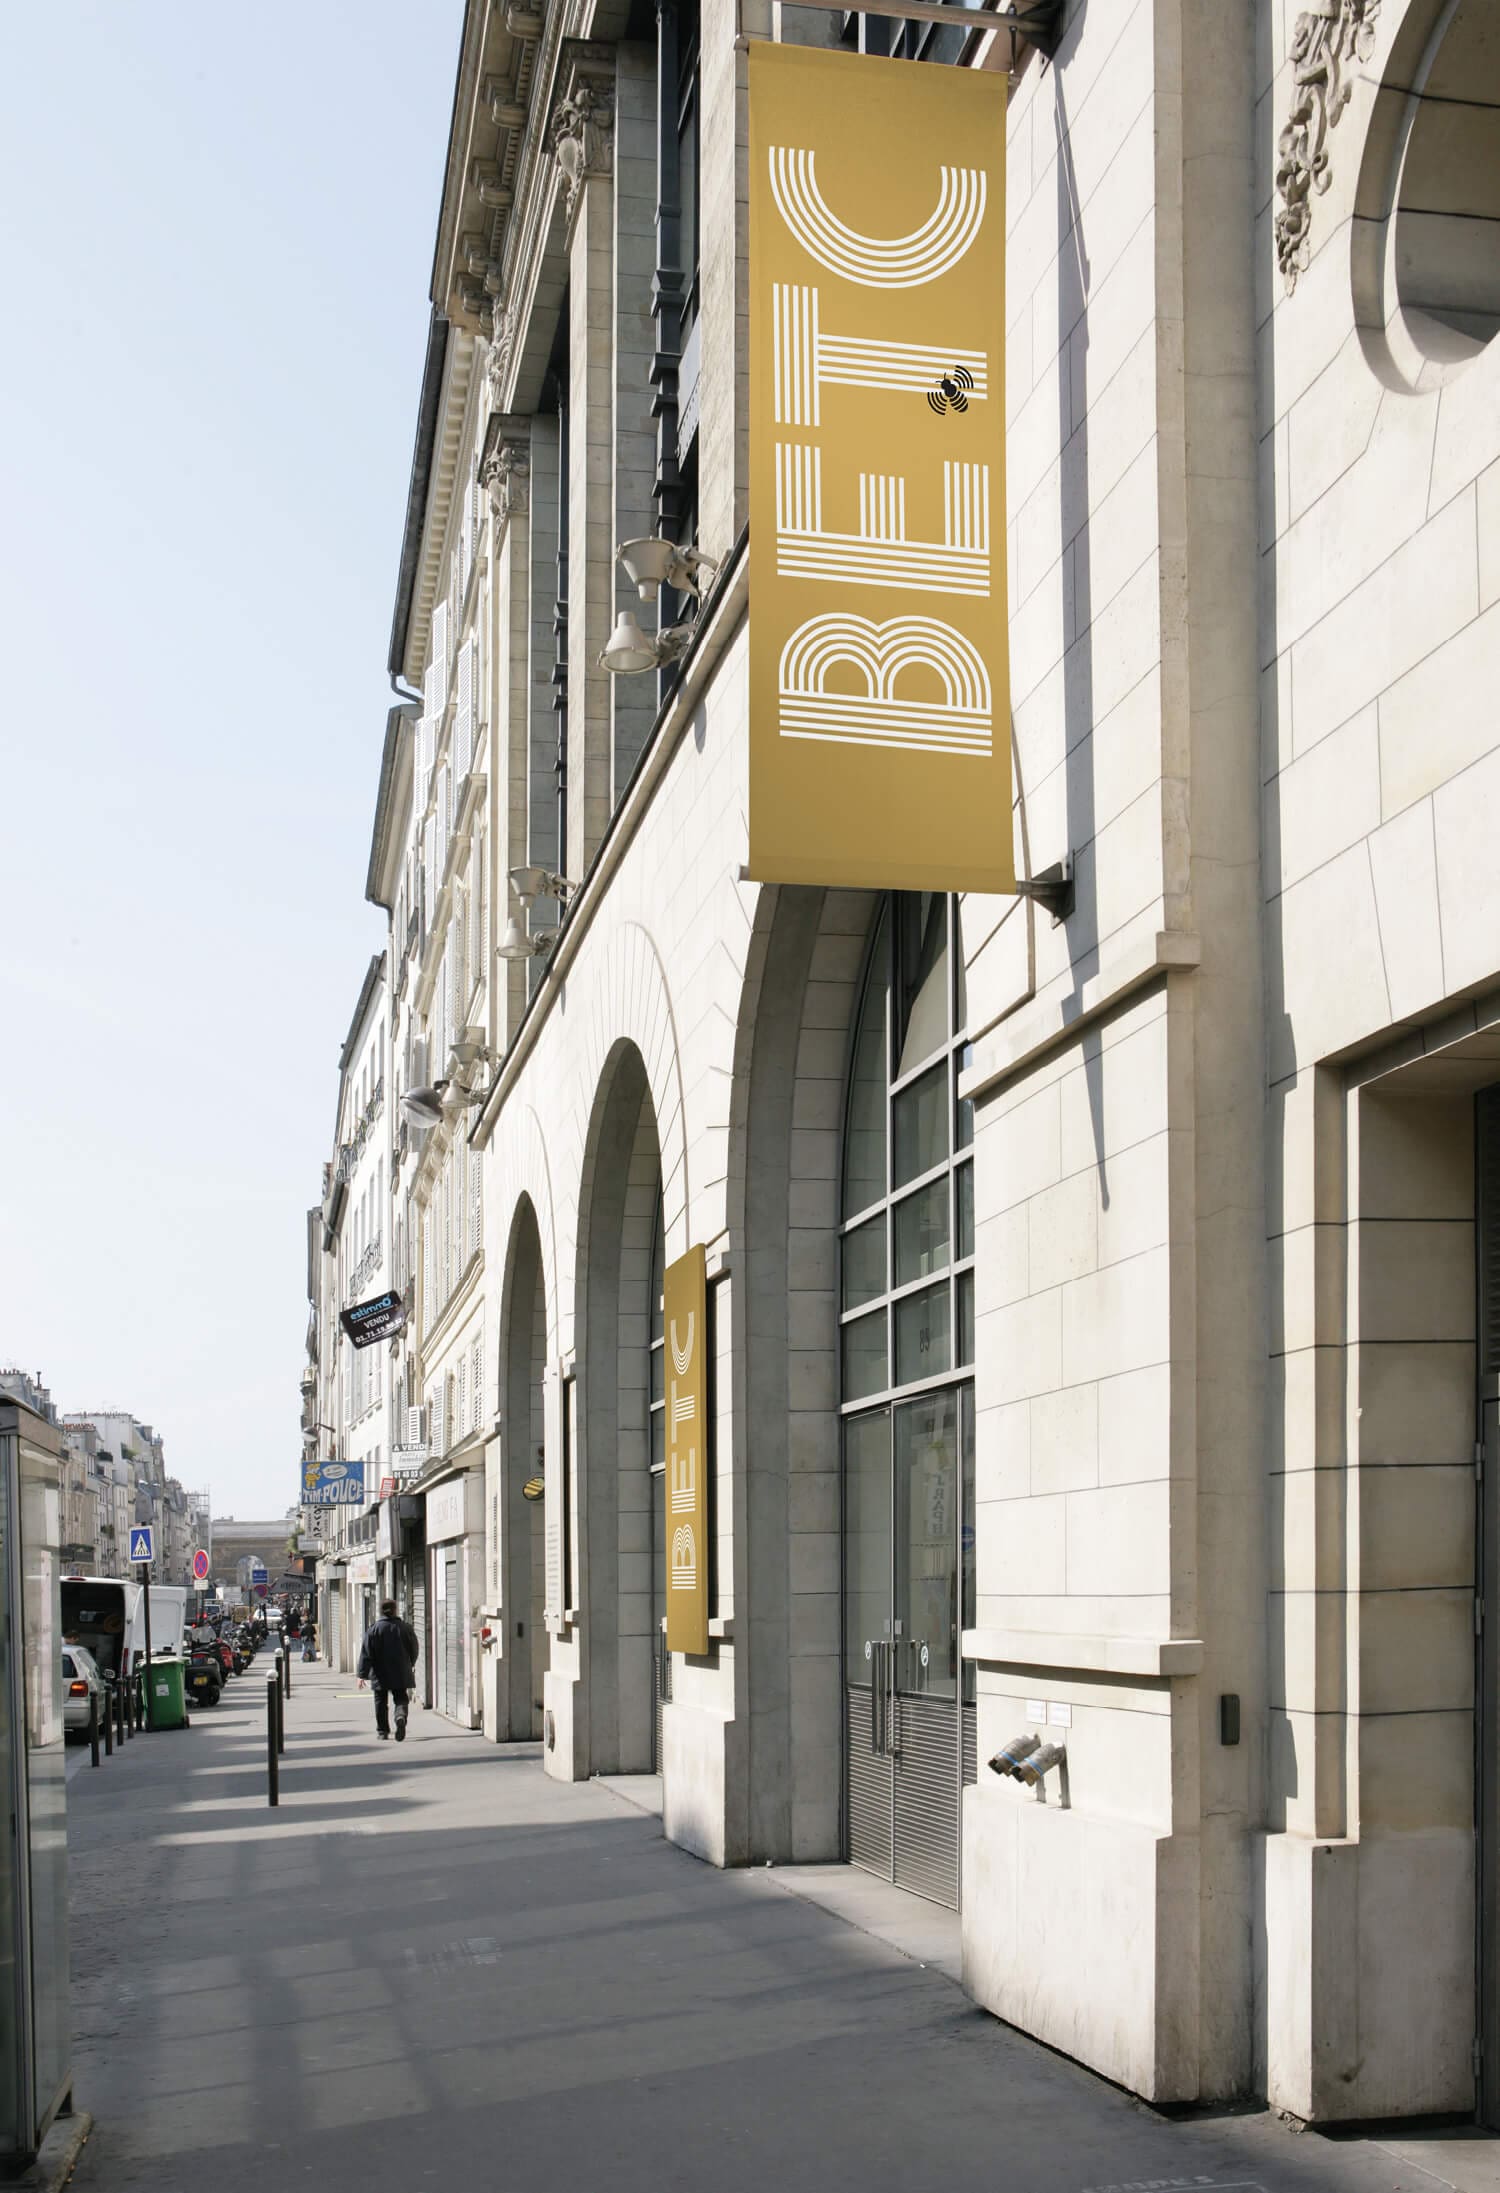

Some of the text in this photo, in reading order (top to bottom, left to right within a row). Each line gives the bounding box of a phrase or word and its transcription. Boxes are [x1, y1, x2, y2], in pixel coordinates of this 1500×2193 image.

[768, 146, 992, 756] BETC
[363, 1313, 390, 1328] VENDU
[670, 1311, 696, 1590] BETC
